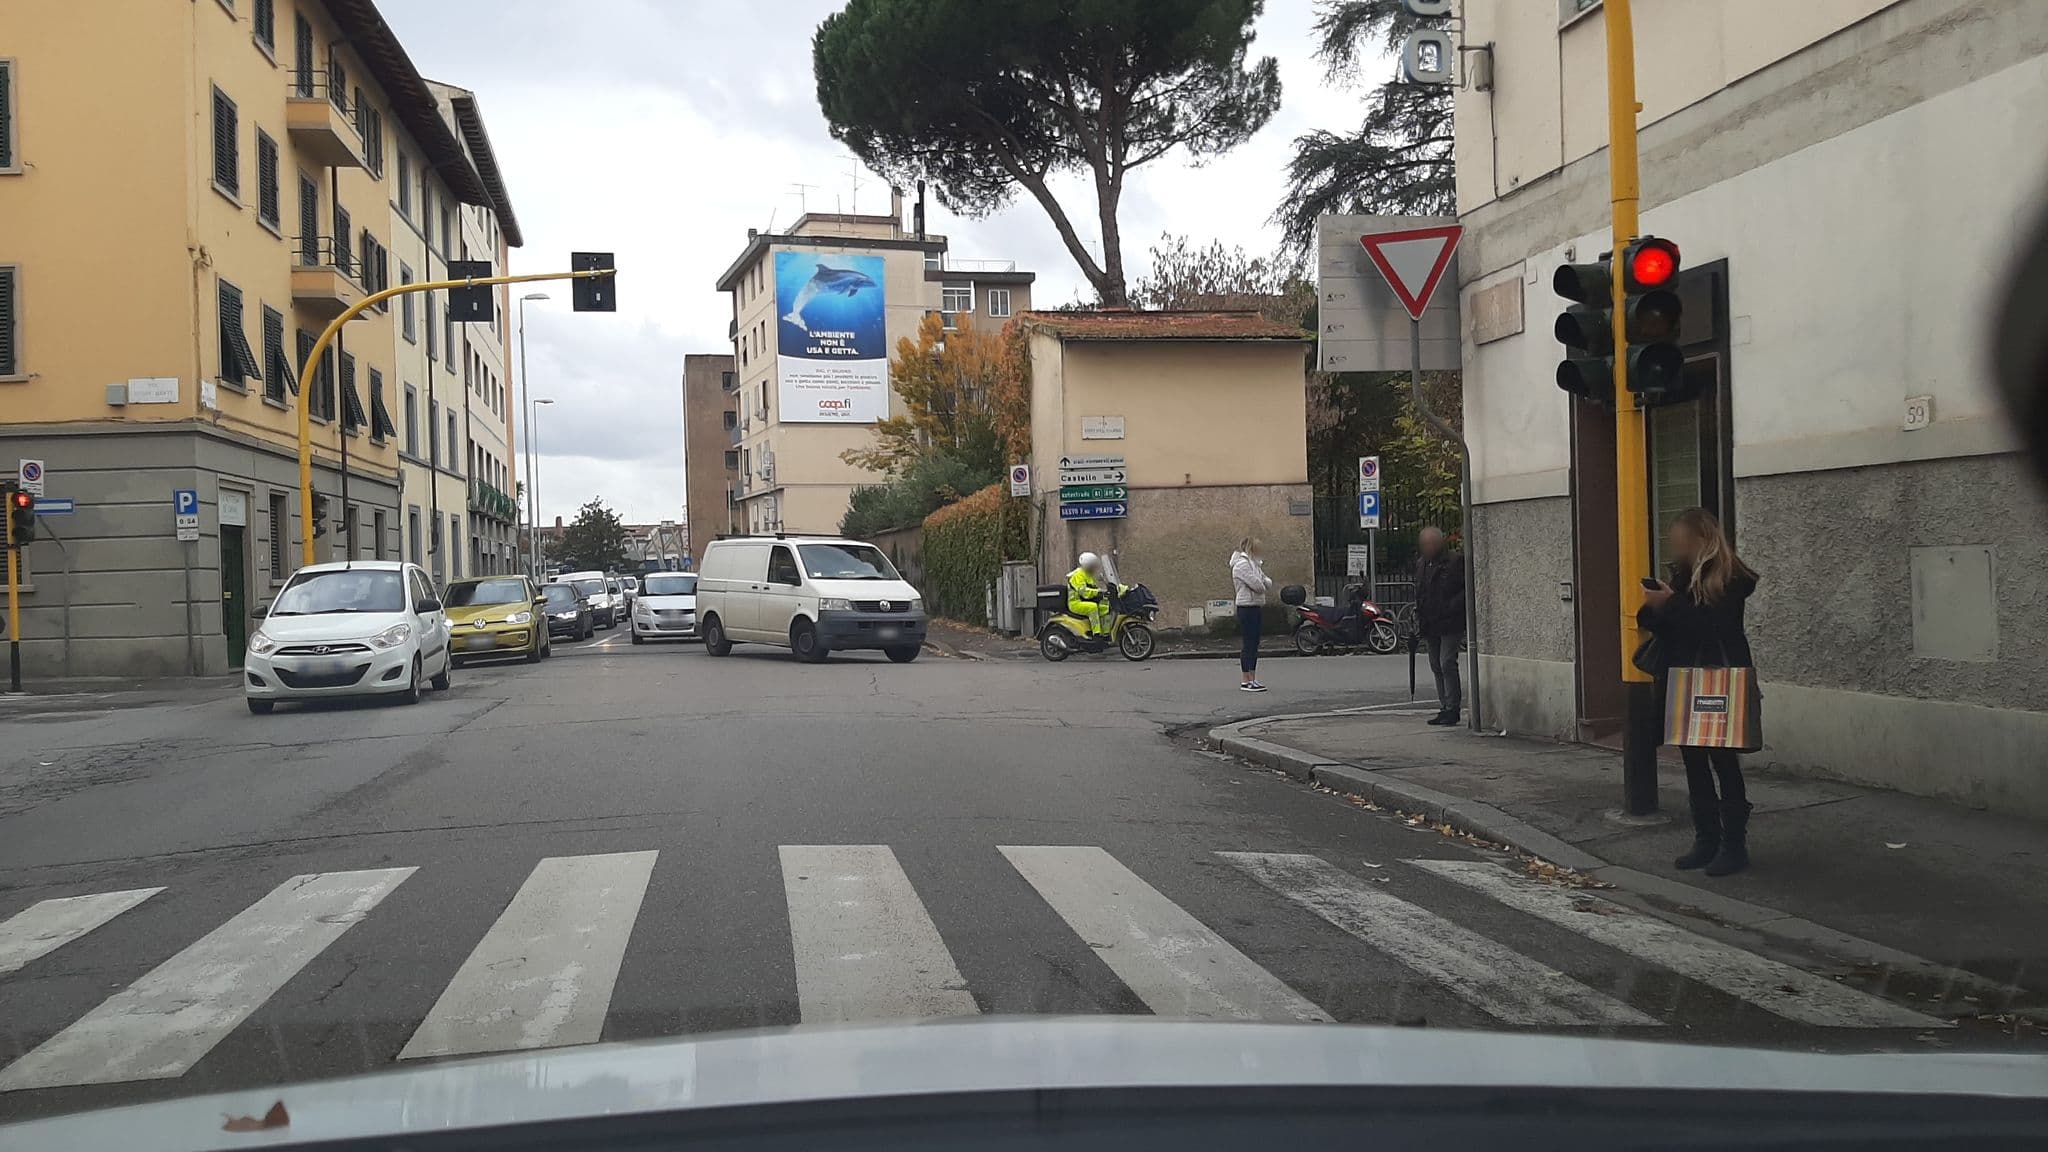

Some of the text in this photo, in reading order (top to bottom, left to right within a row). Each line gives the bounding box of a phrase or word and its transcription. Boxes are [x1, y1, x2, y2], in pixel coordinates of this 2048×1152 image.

[809, 331, 855, 339] L'AMBIENTE
[1907, 406, 1924, 424] 59
[1061, 474, 1097, 482] Castello
[179, 492, 193, 513] P
[1363, 494, 1376, 514] P
